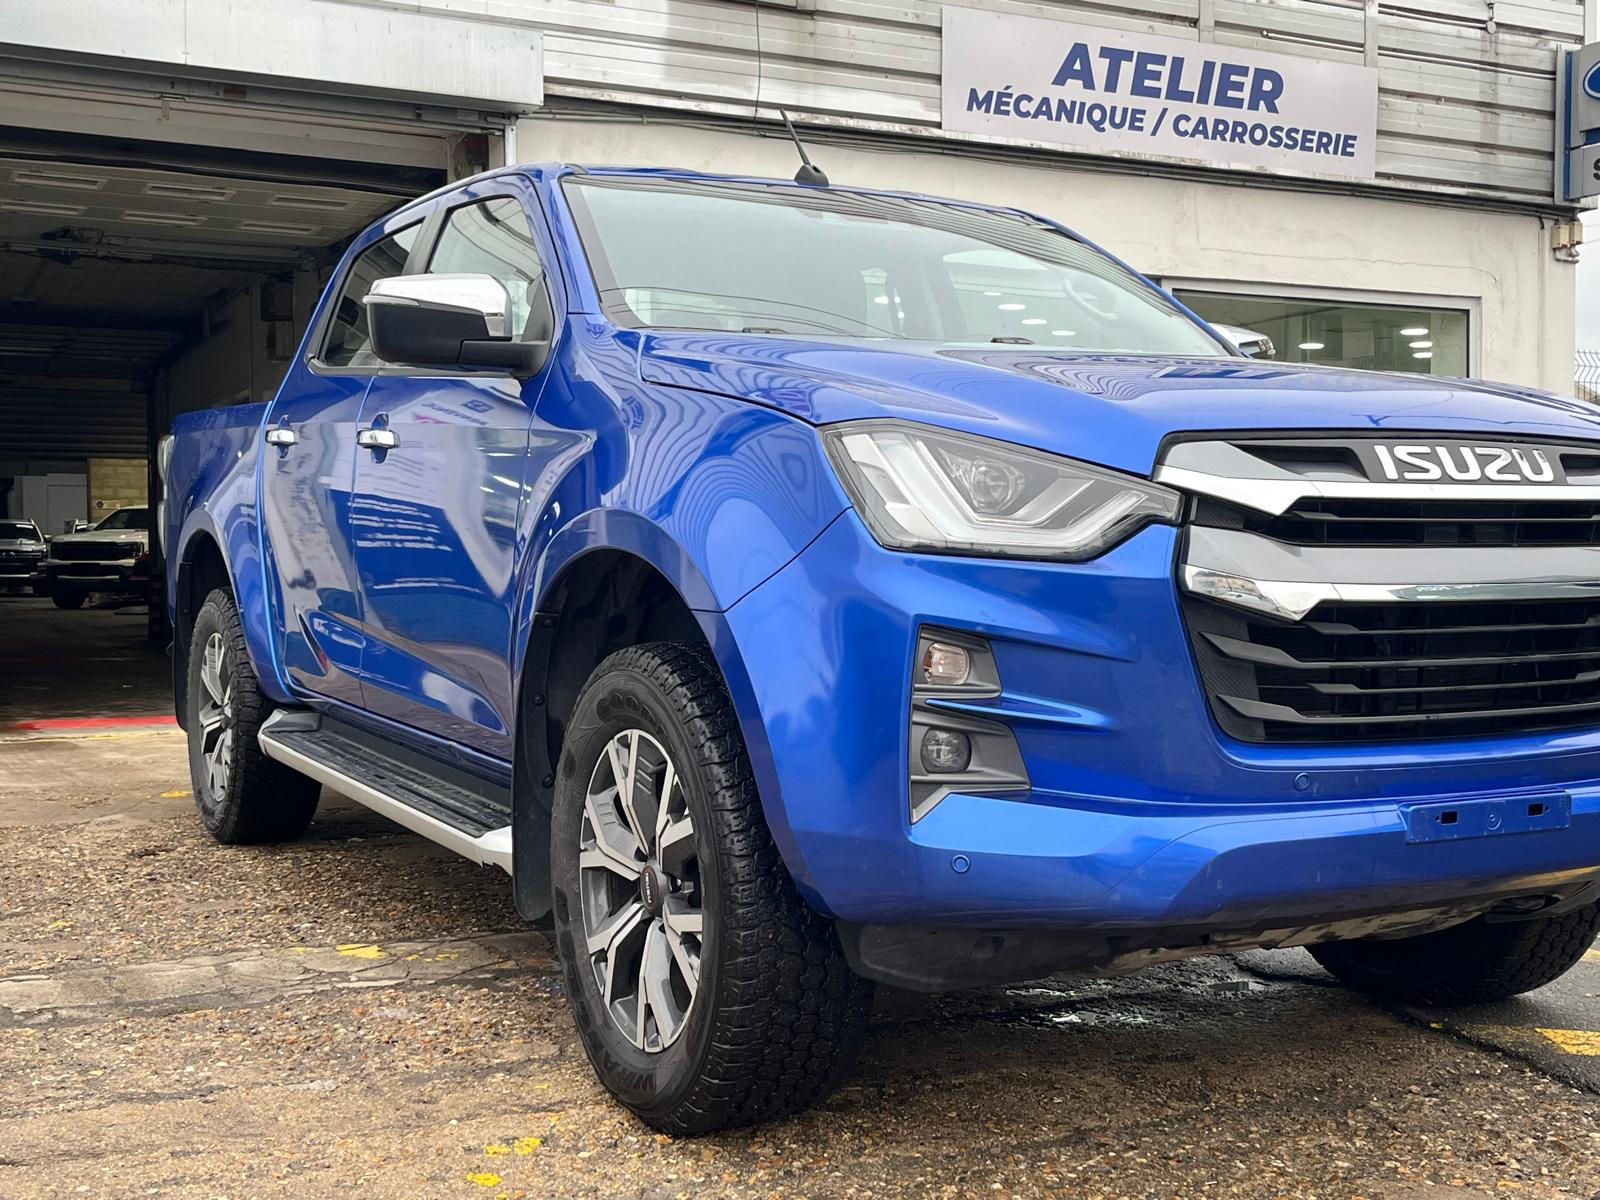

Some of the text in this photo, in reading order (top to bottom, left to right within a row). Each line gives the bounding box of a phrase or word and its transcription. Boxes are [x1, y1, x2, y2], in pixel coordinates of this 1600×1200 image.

[1052, 42, 1285, 114] ATELIER
[966, 85, 1358, 158] MÉCANIQUE / CARROSSERIE
[1373, 444, 1555, 482] ISUZU
